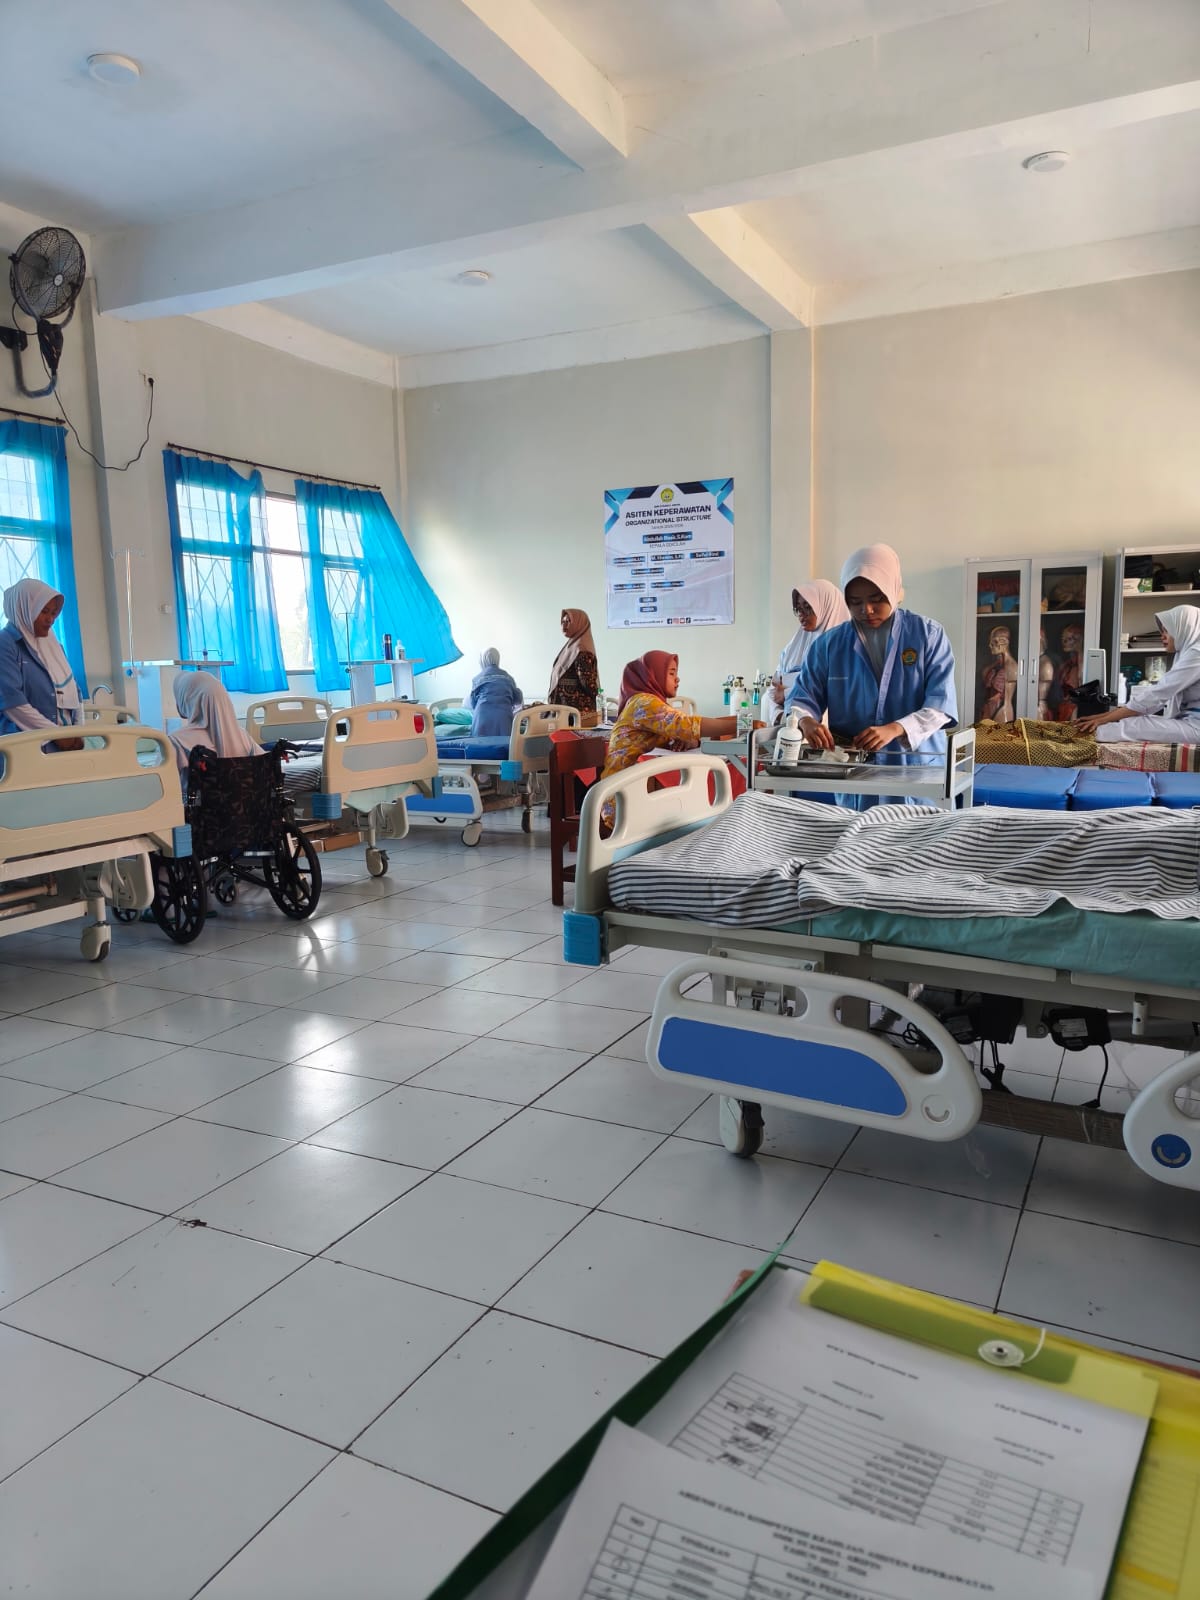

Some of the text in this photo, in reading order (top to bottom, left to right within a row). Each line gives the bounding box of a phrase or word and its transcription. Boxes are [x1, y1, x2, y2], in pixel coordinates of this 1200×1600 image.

[625, 510, 653, 519] ASITEN
[654, 505, 712, 516] KEPERAWATAN
[625, 514, 712, 527] ORGANIZATIONAL STRUCTURE
